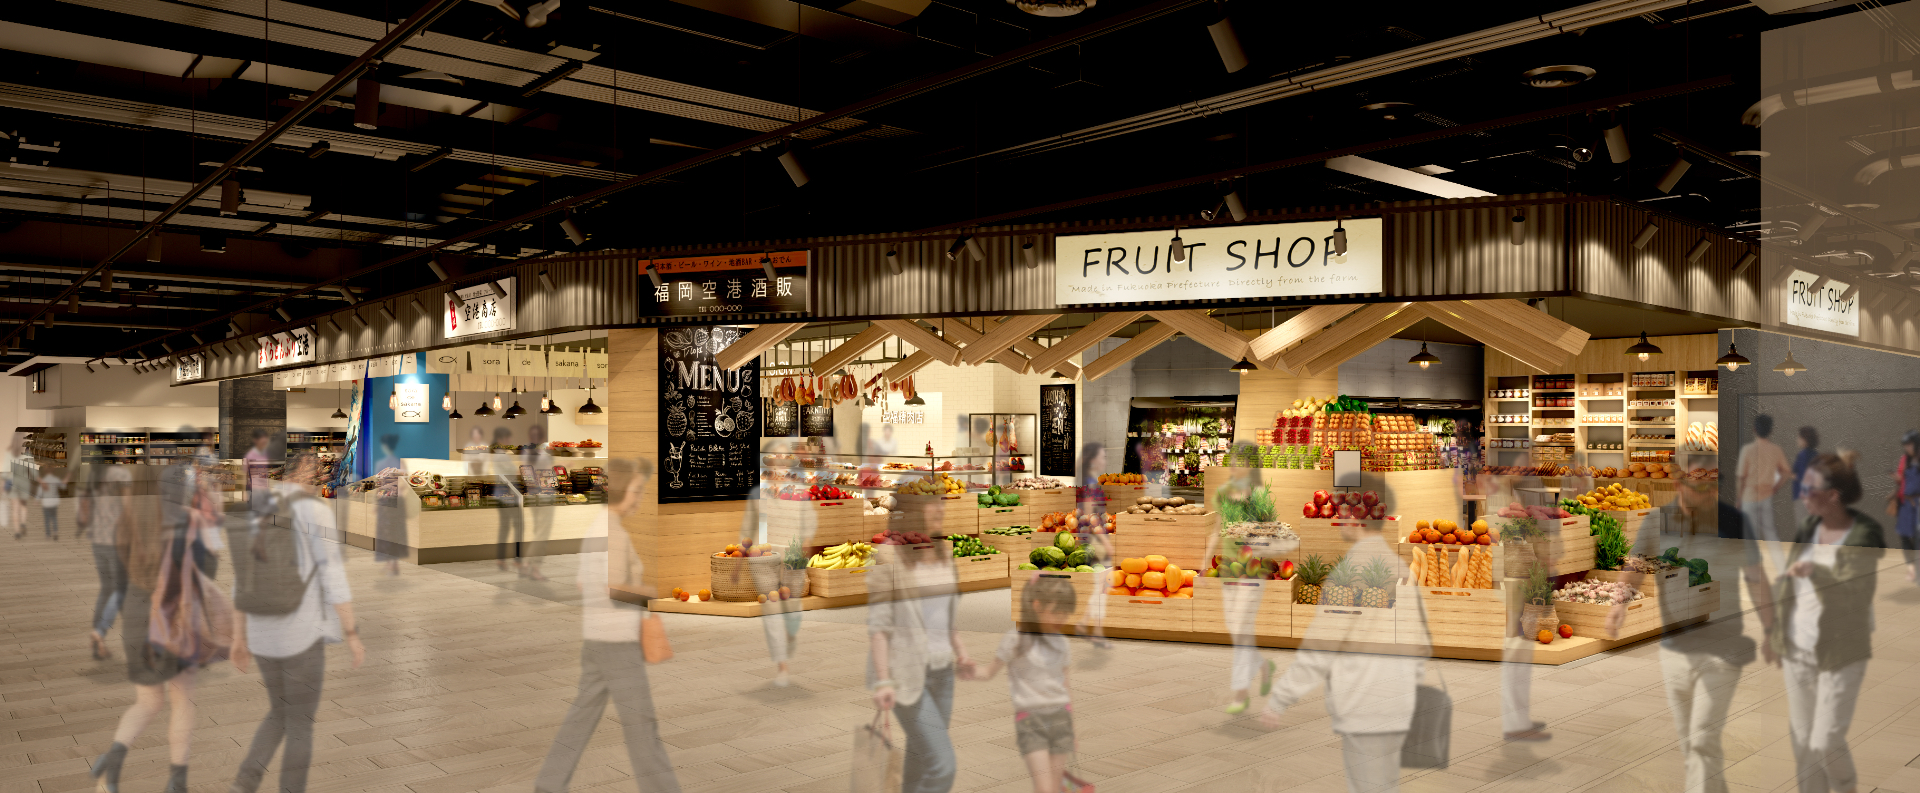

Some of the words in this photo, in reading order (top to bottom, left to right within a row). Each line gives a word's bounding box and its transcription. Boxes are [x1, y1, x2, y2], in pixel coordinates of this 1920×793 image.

[1083, 242, 1207, 277] FRUIT
[1226, 235, 1347, 271] SHOP
[654, 277, 792, 303] 福岡空港酒販
[1071, 284, 1098, 293] Made
[1102, 284, 1113, 292] in
[1117, 282, 1163, 291] Fukuoka
[1167, 279, 1221, 290] Prefecture
[1228, 278, 1273, 288] Directly
[1277, 276, 1304, 286] from
[1308, 275, 1325, 283] the
[1329, 274, 1358, 284] farm
[465, 298, 497, 322] 空港商店
[1793, 280, 1824, 308] FRUIT
[1828, 288, 1854, 314] SHOP
[555, 359, 579, 367] sakana
[677, 360, 741, 393] MENU
